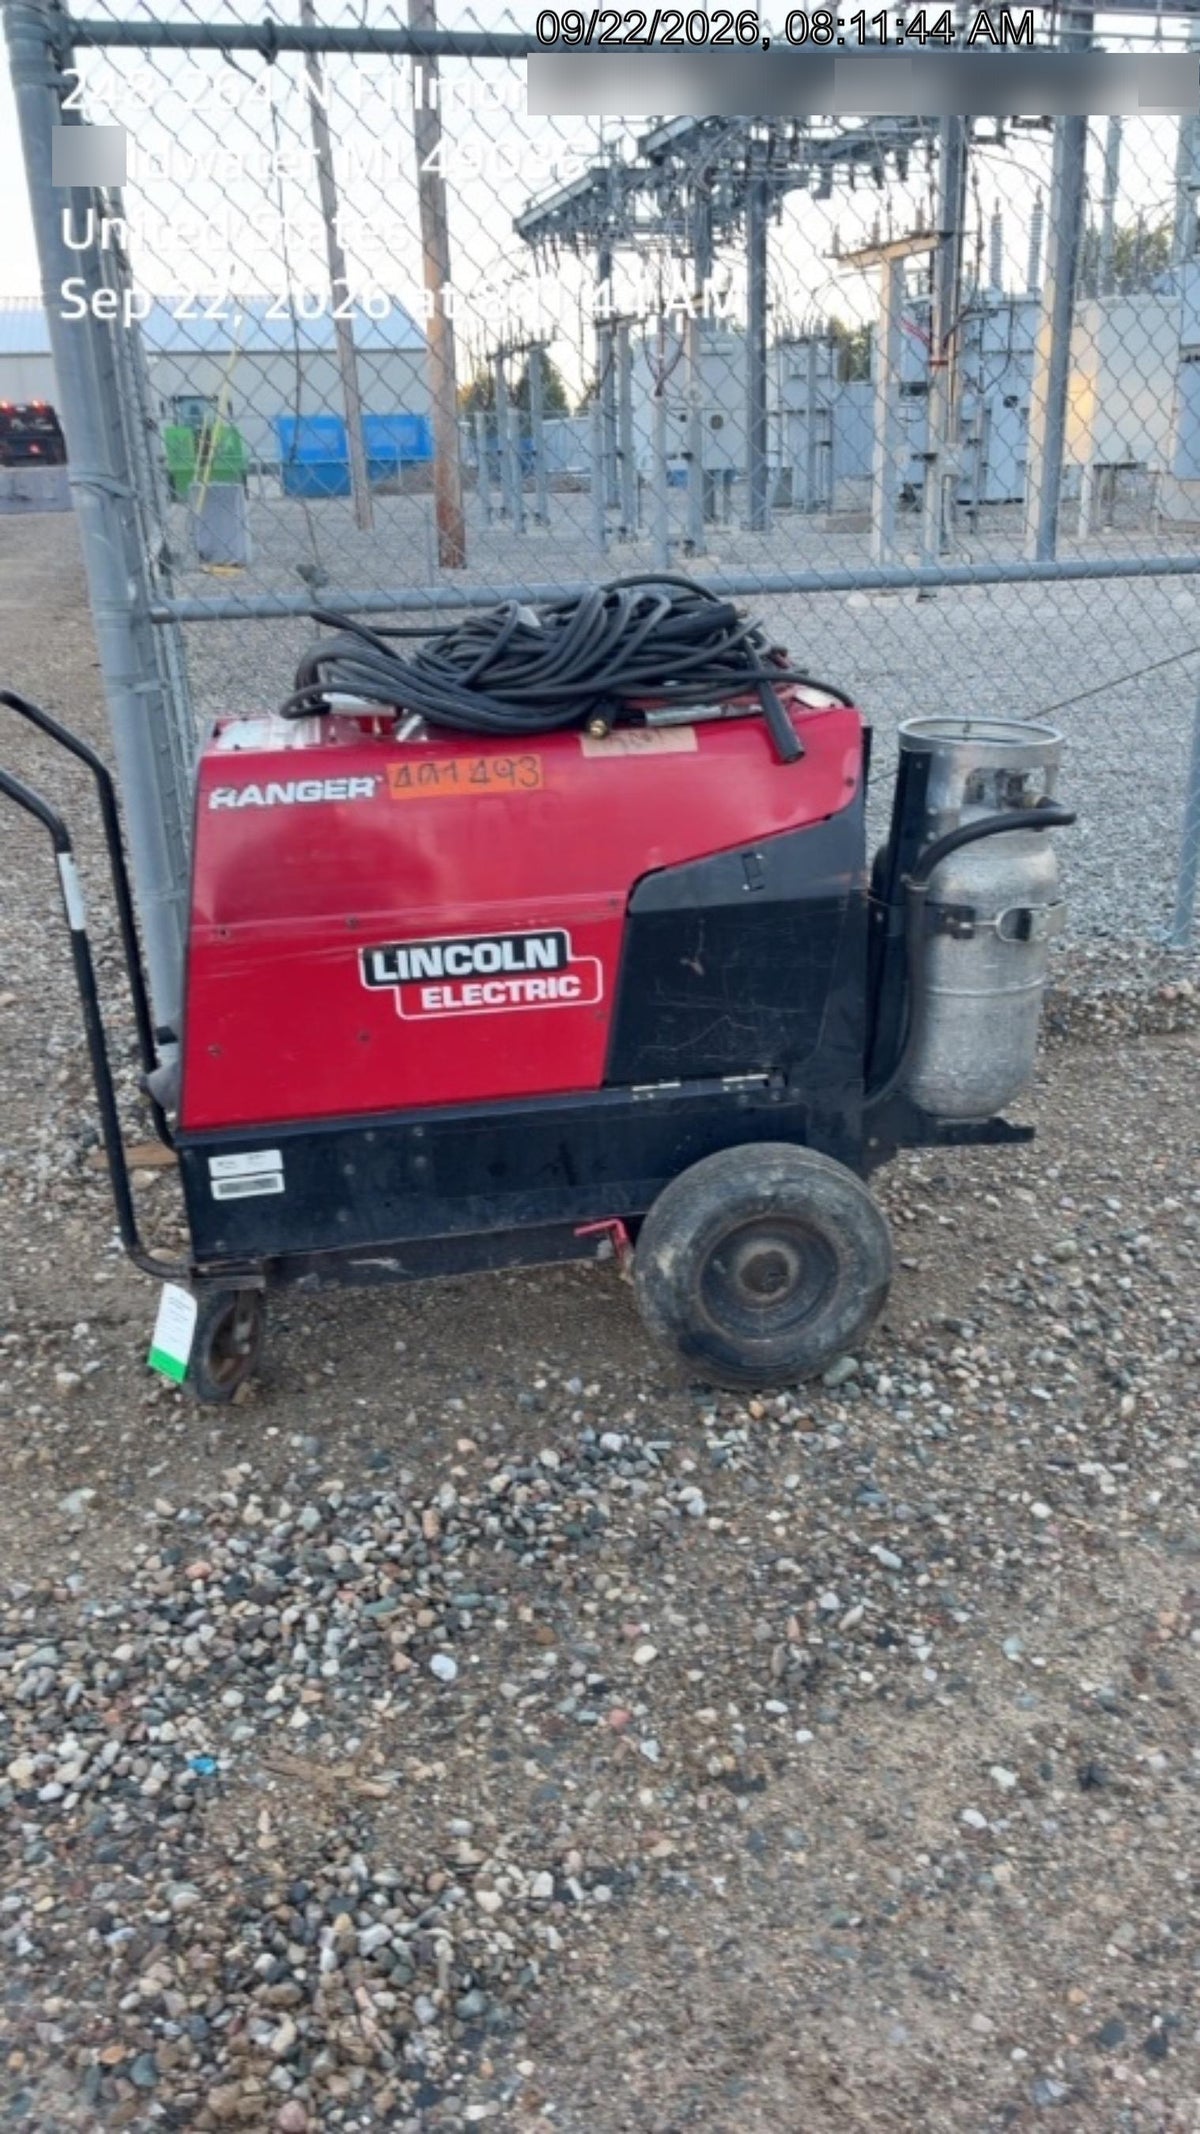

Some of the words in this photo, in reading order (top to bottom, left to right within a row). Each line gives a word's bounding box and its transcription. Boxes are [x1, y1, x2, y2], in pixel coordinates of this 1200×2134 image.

[208, 776, 377, 809] RANGER
[372, 938, 560, 982] LINCOLN
[421, 975, 582, 1010] ELECTRIC
